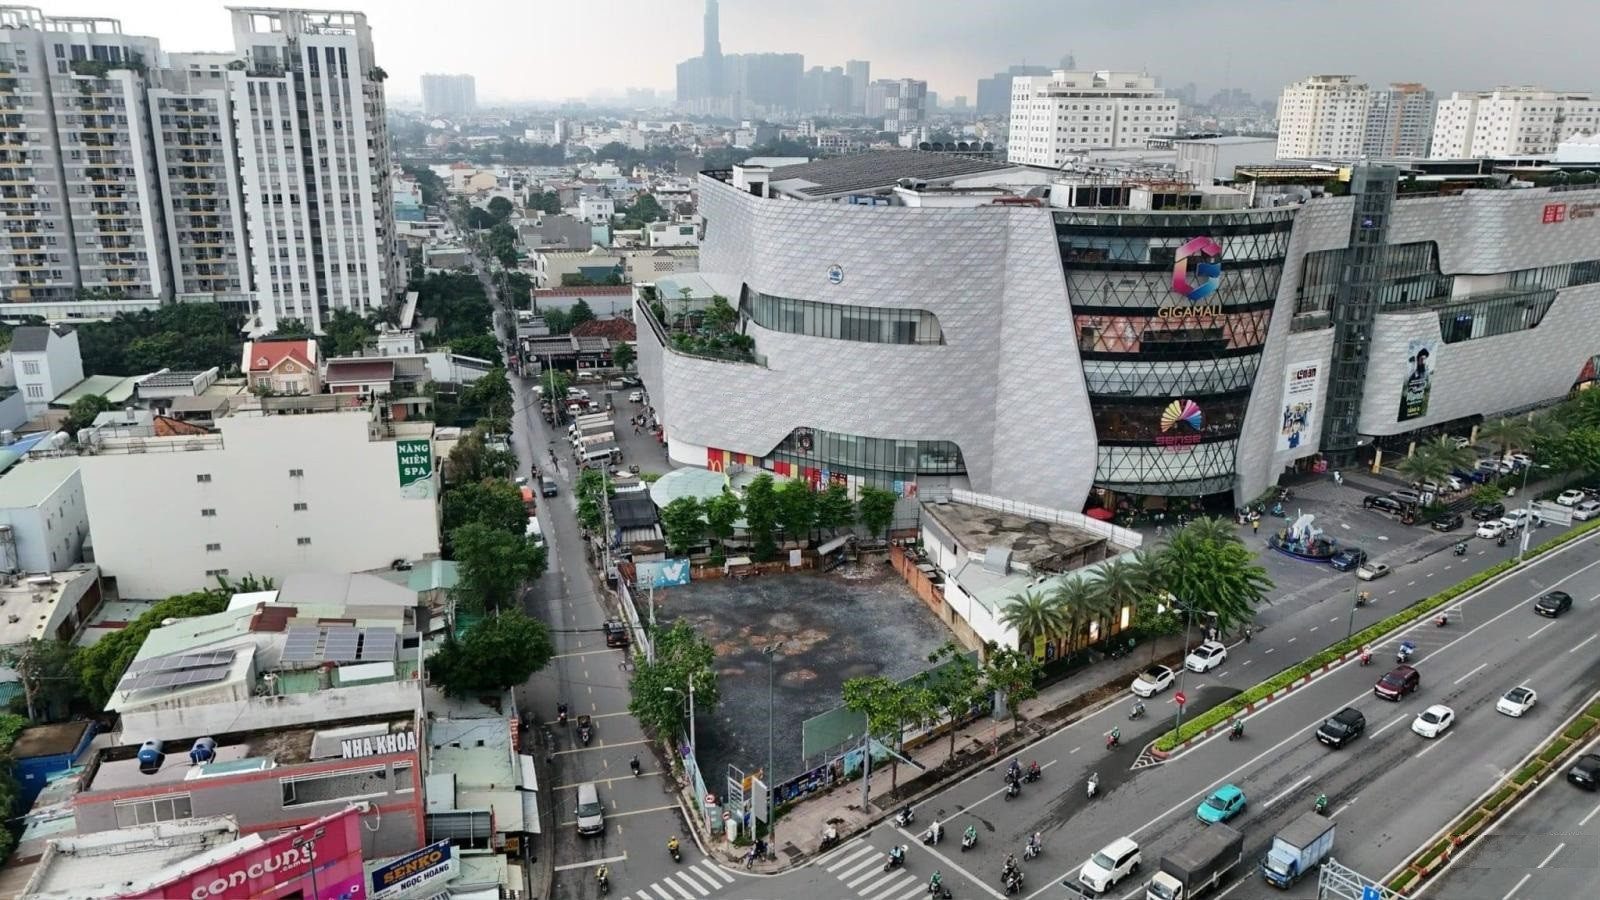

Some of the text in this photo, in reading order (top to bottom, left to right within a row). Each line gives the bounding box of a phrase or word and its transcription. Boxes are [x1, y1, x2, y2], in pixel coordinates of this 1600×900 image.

[1158, 304, 1224, 318] GIGAMALL
[399, 443, 429, 453] NÀNG
[404, 467, 427, 475] SPA
[342, 731, 417, 759] NHA KHOA
[384, 851, 442, 885] SENKO
